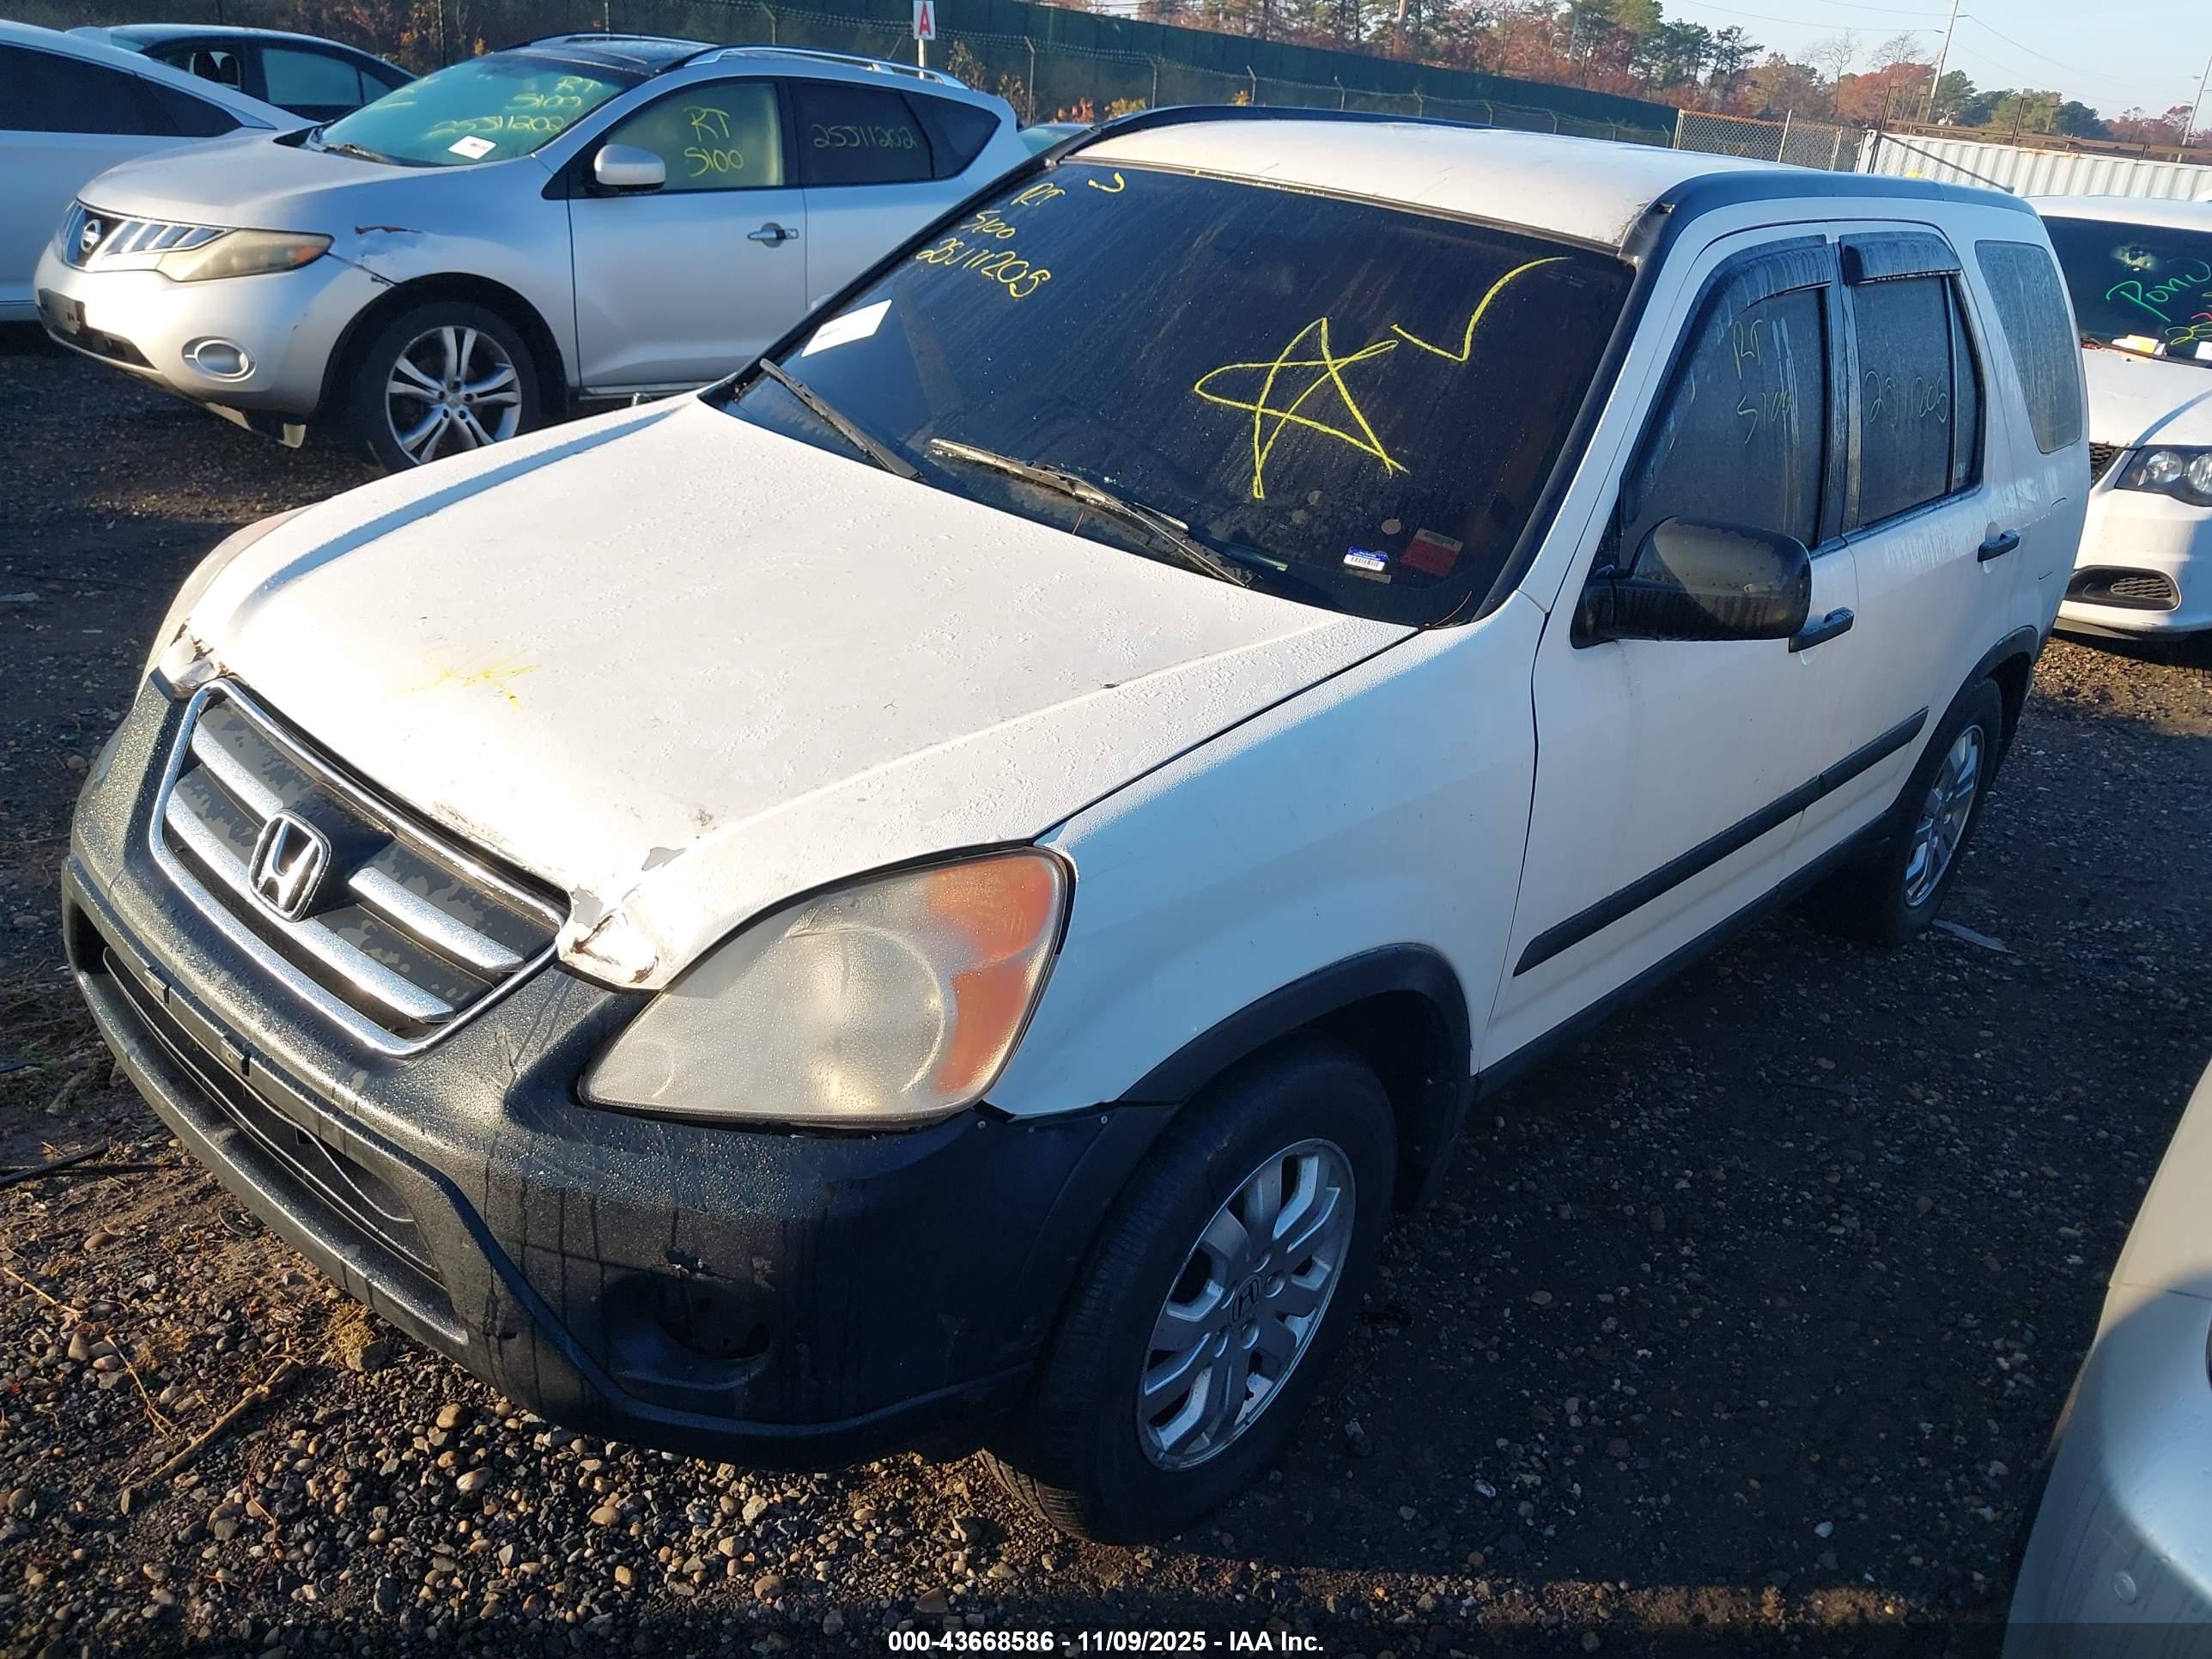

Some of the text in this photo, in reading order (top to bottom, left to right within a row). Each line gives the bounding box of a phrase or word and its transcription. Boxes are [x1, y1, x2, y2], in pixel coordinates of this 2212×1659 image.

[919, 3, 931, 35] A
[684, 106, 730, 142] RT
[1010, 182, 1066, 207] RT
